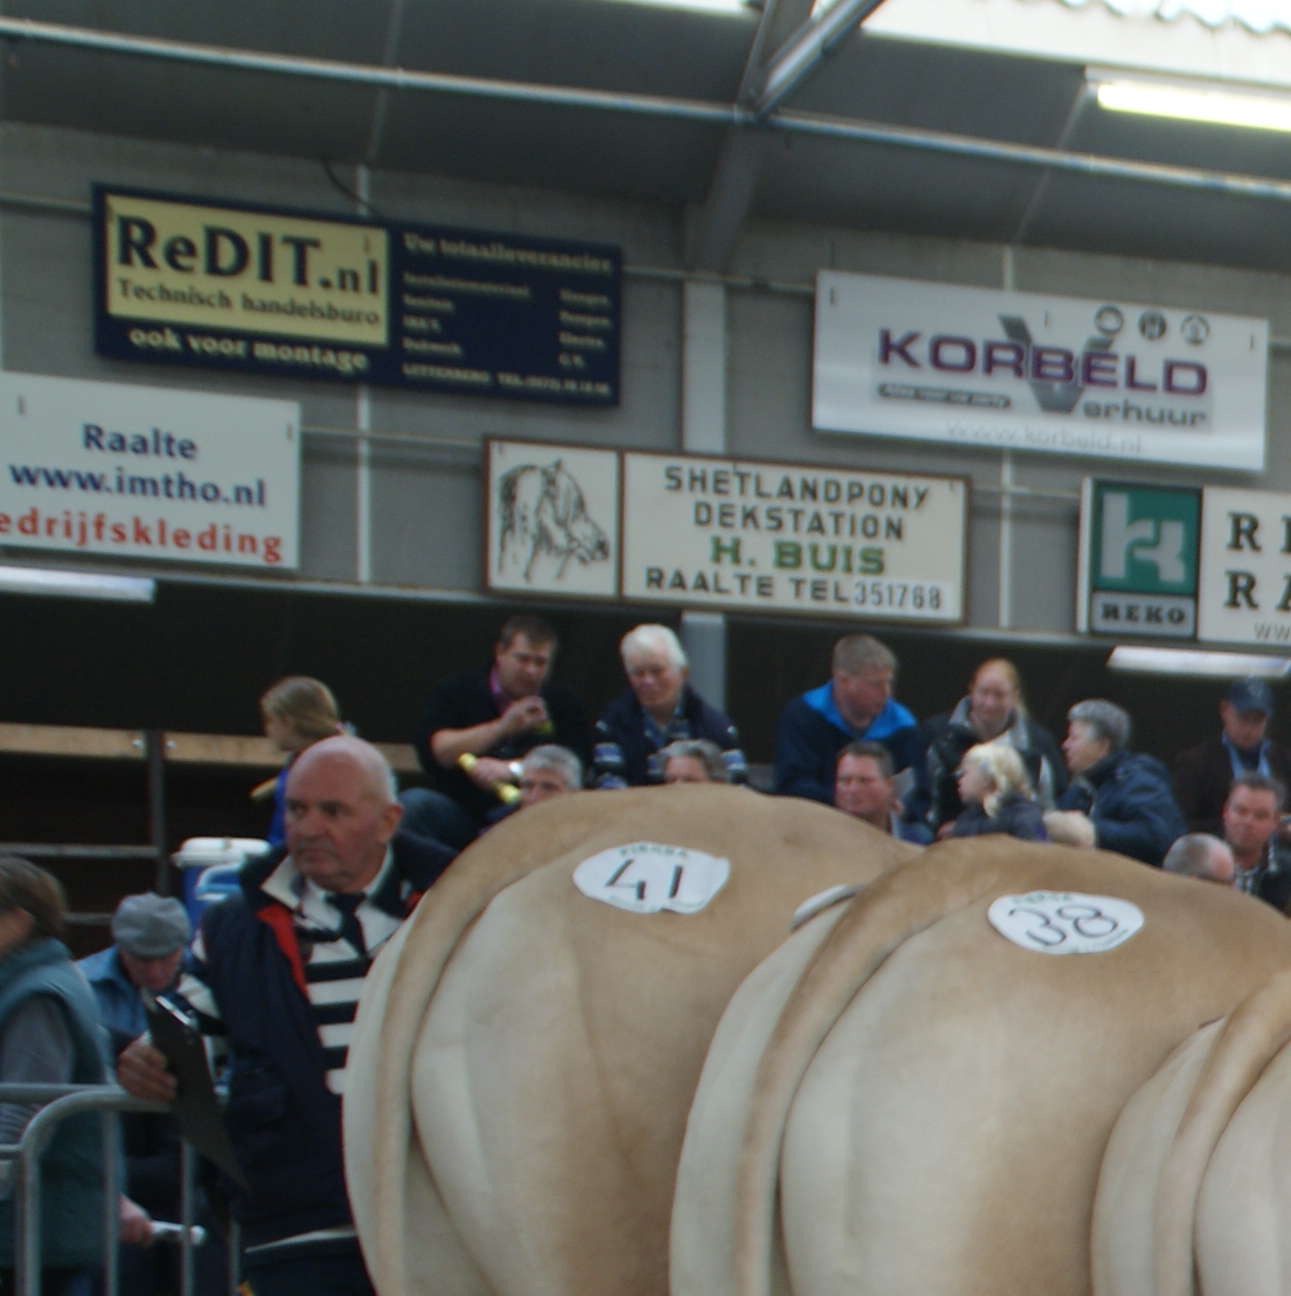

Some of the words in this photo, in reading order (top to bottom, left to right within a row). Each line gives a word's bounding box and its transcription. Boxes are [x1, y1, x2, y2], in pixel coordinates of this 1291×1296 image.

[116, 214, 380, 296] ReDIT.nl
[118, 277, 233, 311] Technisch
[240, 291, 380, 327] handelsburo
[130, 326, 180, 351] ook
[188, 333, 247, 358] voor
[254, 337, 368, 372] montage
[877, 327, 1208, 396] KORBELD
[82, 423, 197, 460] Raalte
[10, 461, 266, 507] www.imtho.nl
[665, 464, 930, 510] SHETLANDPONY
[0, 508, 283, 564] edrijfskleding
[694, 501, 903, 541] DEKSTATION
[710, 536, 756, 567] H.
[773, 537, 886, 577] BUIS
[646, 566, 774, 598] RAALTE
[1102, 602, 1186, 625] REKO
[605, 857, 684, 901] 41
[1008, 903, 1119, 947] 38
